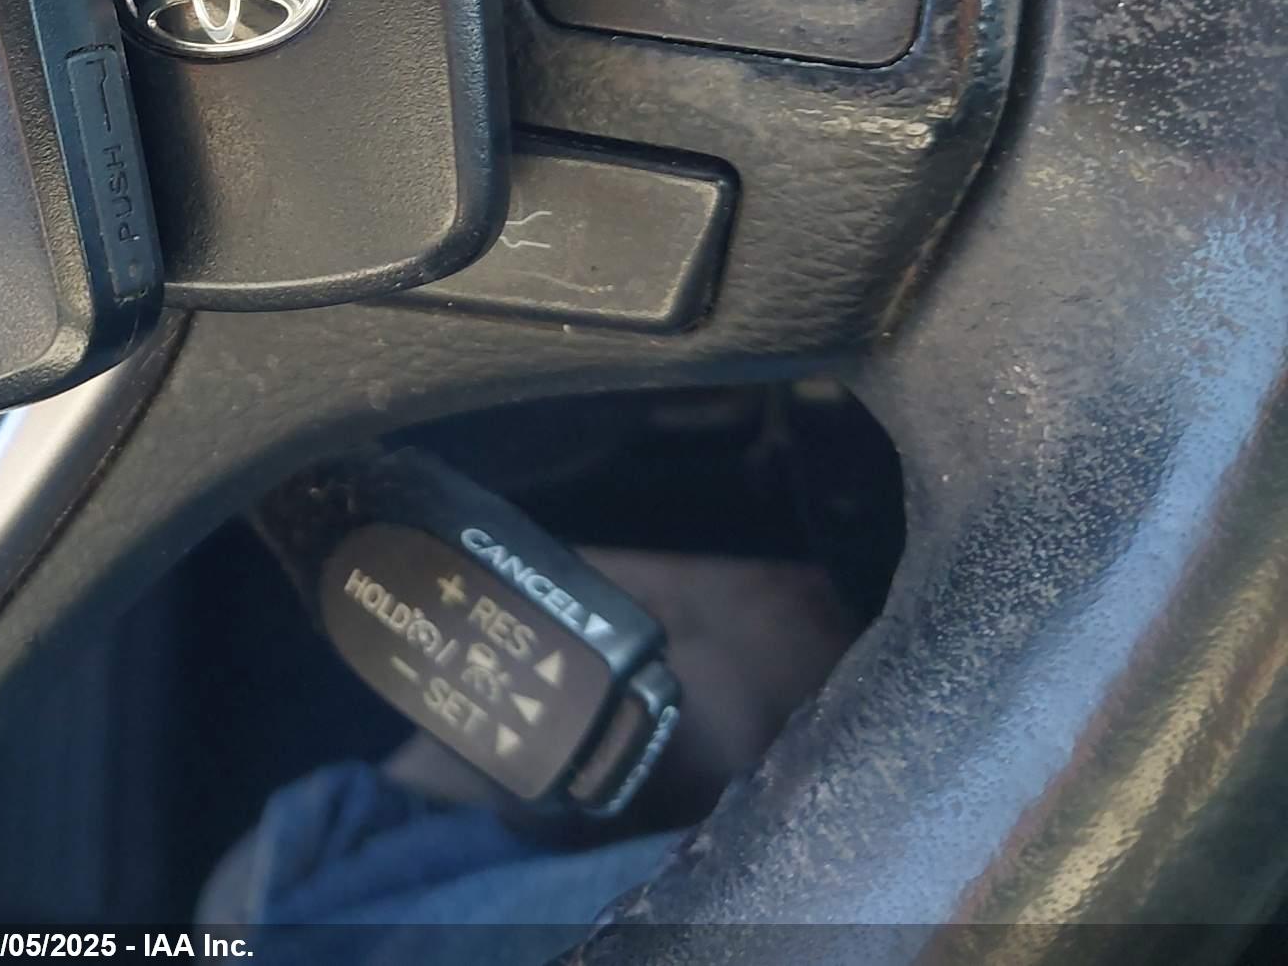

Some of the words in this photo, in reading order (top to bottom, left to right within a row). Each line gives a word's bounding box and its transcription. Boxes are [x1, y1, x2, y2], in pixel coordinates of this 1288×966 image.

[102, 145, 140, 243] PUSH
[461, 527, 585, 632] CANCEL
[467, 595, 539, 662] RES
[422, 676, 490, 735] SET
